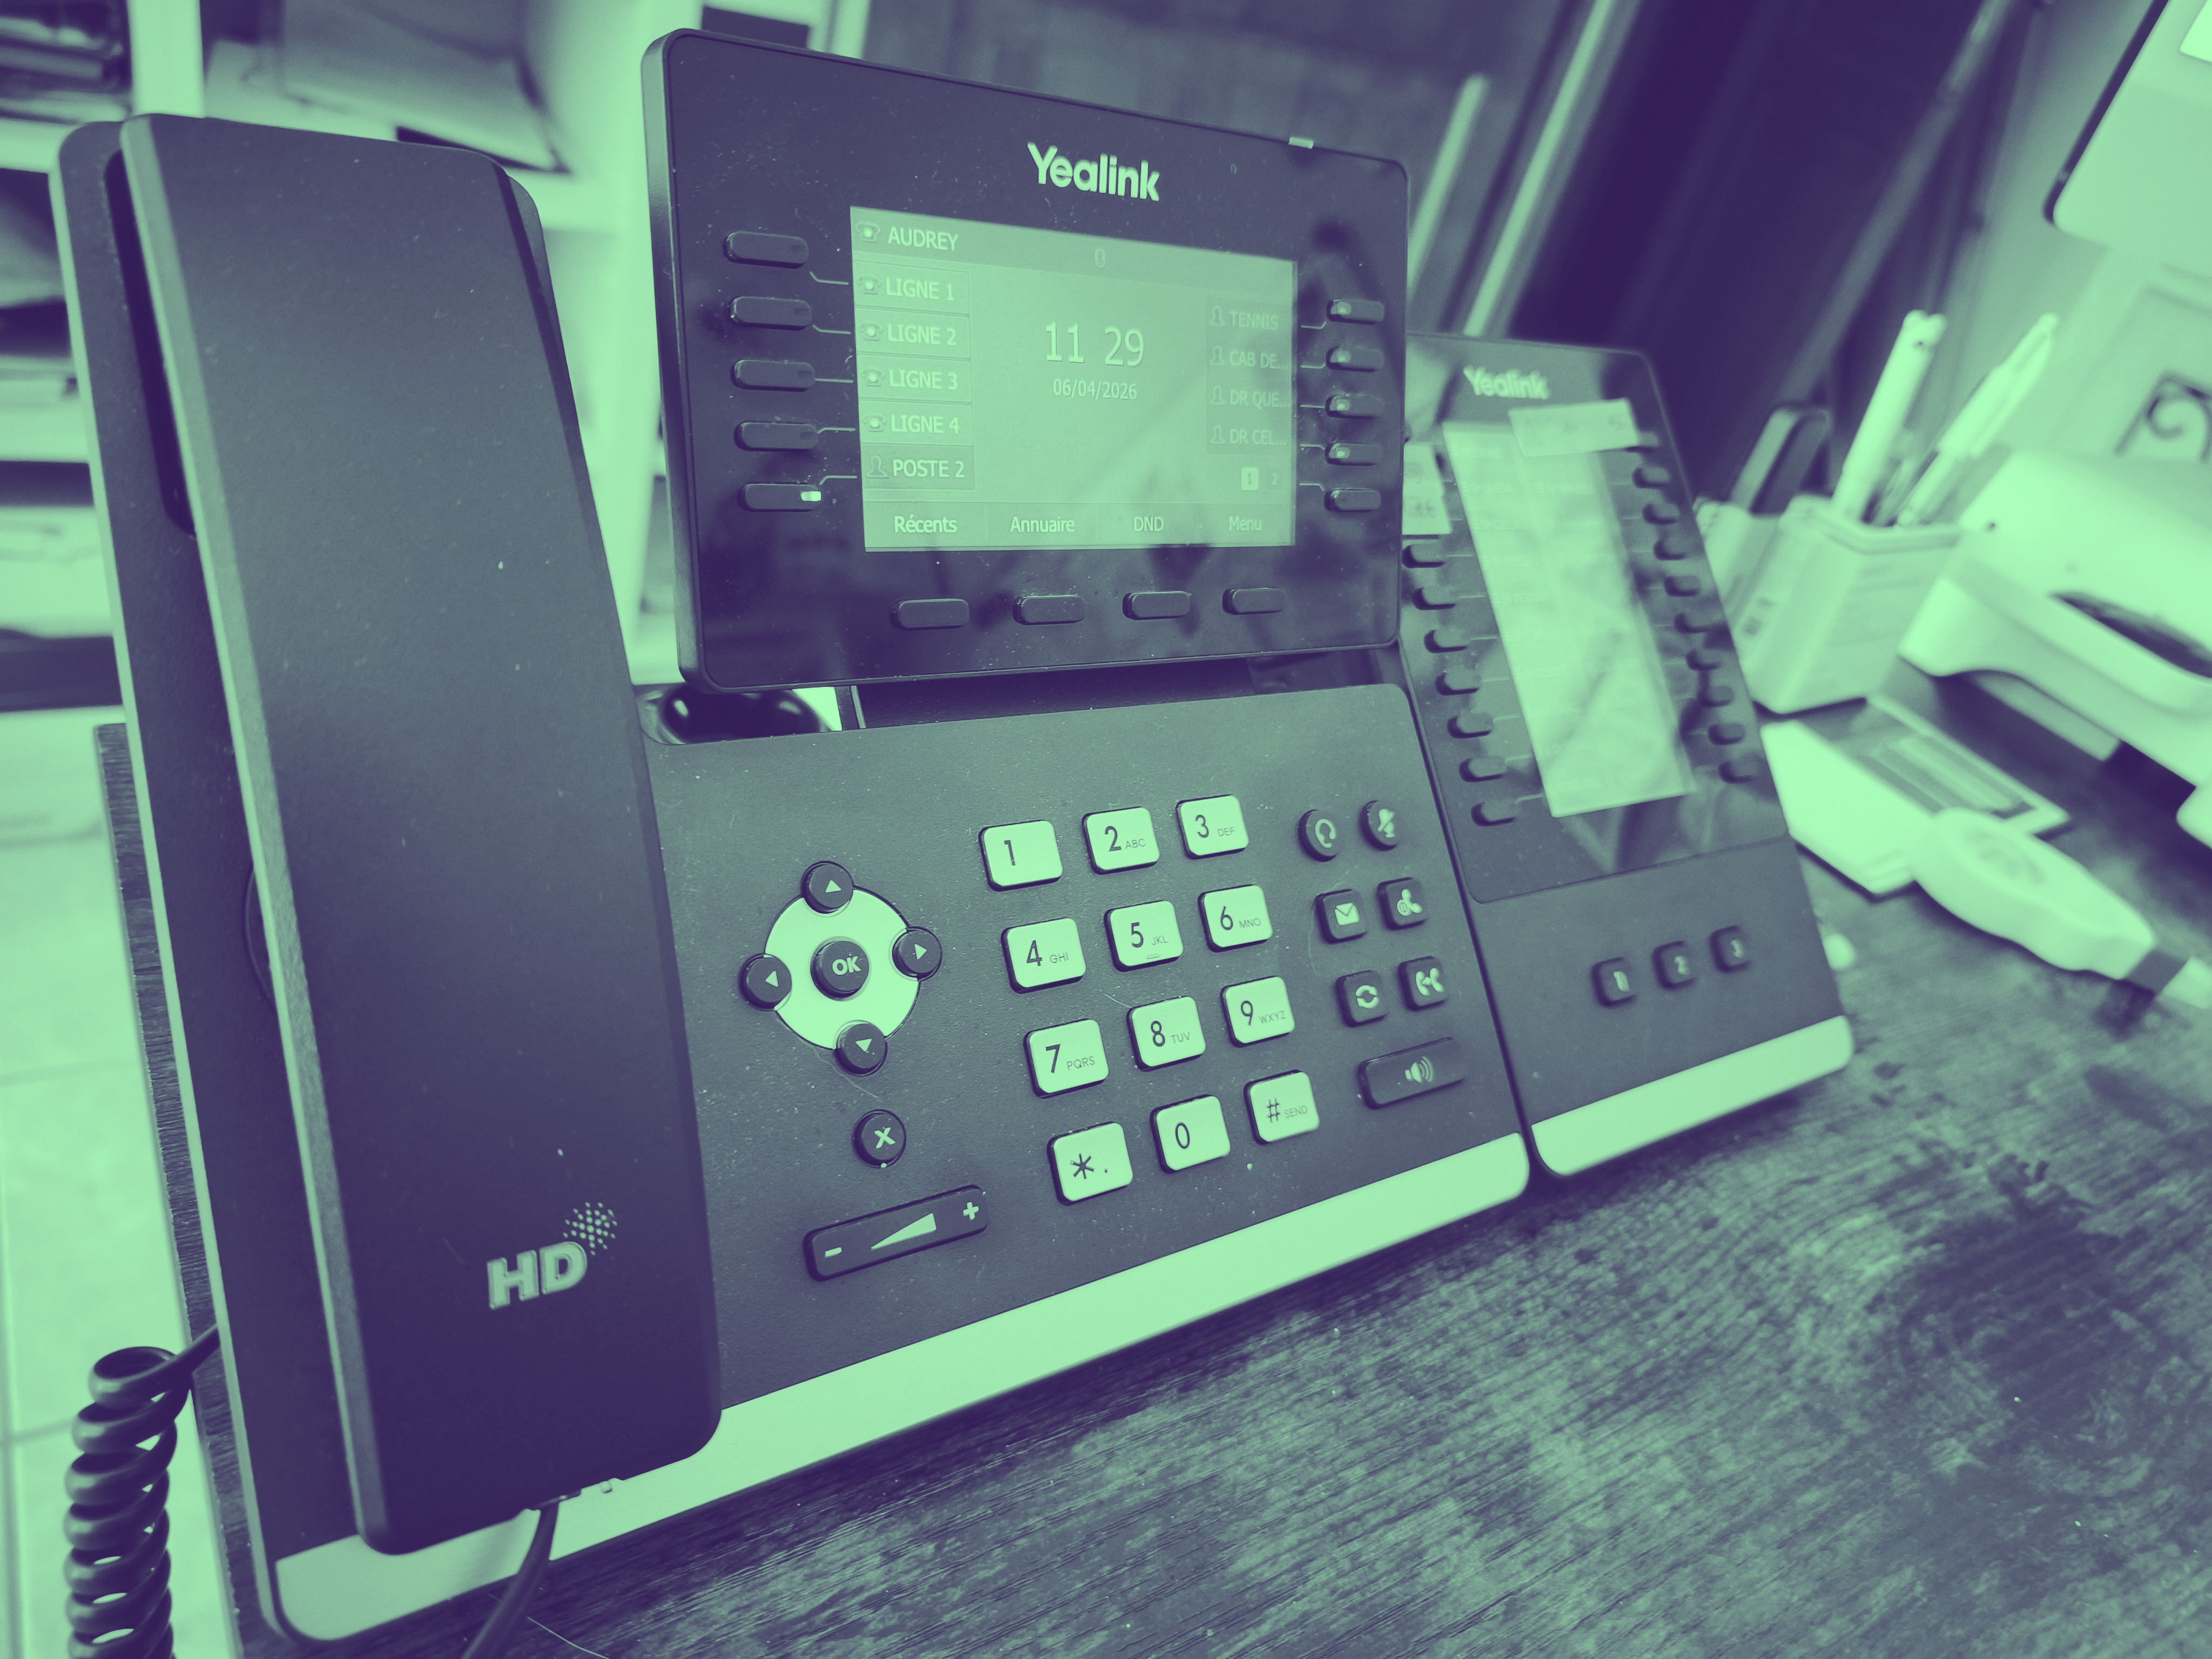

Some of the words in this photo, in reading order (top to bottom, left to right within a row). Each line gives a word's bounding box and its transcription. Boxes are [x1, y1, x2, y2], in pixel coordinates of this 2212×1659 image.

[1027, 141, 1160, 201] Yealink
[888, 226, 959, 251] AUDREY
[886, 277, 940, 300] LIGNE
[946, 284, 955, 301] 1
[1229, 311, 1278, 331] TENNIS
[887, 323, 941, 345] LIGNE
[946, 328, 957, 346] 2
[1046, 322, 1084, 363] 11
[1104, 326, 1144, 367] 29
[1229, 350, 1256, 367] CAB
[889, 369, 942, 389] LIGNE
[948, 372, 958, 390] 3
[1053, 379, 1137, 401] 06/04/2026
[1463, 365, 1549, 400] Yealink
[1230, 390, 1248, 406] DR
[891, 414, 944, 433] LIGNE
[948, 417, 960, 434] 4
[1230, 429, 1248, 444] DR
[893, 459, 950, 478] POSTE
[955, 461, 965, 478] 2
[1271, 474, 1278, 485] 2
[894, 514, 957, 534] Récents
[1010, 516, 1075, 533] Annuaire
[1134, 516, 1164, 532] DND
[1229, 516, 1263, 531] Menu
[1195, 814, 1209, 838] 3
[1217, 827, 1235, 837] DEF
[1104, 826, 1122, 852] 2
[1125, 838, 1146, 849] ABC
[1004, 840, 1016, 866] 1
[1219, 906, 1233, 931] 6
[1239, 918, 1262, 929] MNO
[1130, 922, 1144, 948] 5
[1151, 935, 1169, 946] JKL
[1026, 940, 1042, 967] 4
[1049, 952, 1069, 964] GHI
[832, 956, 861, 975] OK
[1240, 1000, 1254, 1026] 9
[1258, 1010, 1286, 1024] WXYZ
[1150, 1020, 1165, 1047] 8
[1171, 1031, 1191, 1044] TUV
[1046, 1044, 1061, 1074] 7
[1066, 1056, 1096, 1071] PQRS
[1284, 1105, 1308, 1119] SEND
[1175, 1122, 1191, 1149] 0
[487, 1241, 588, 1311] HD
